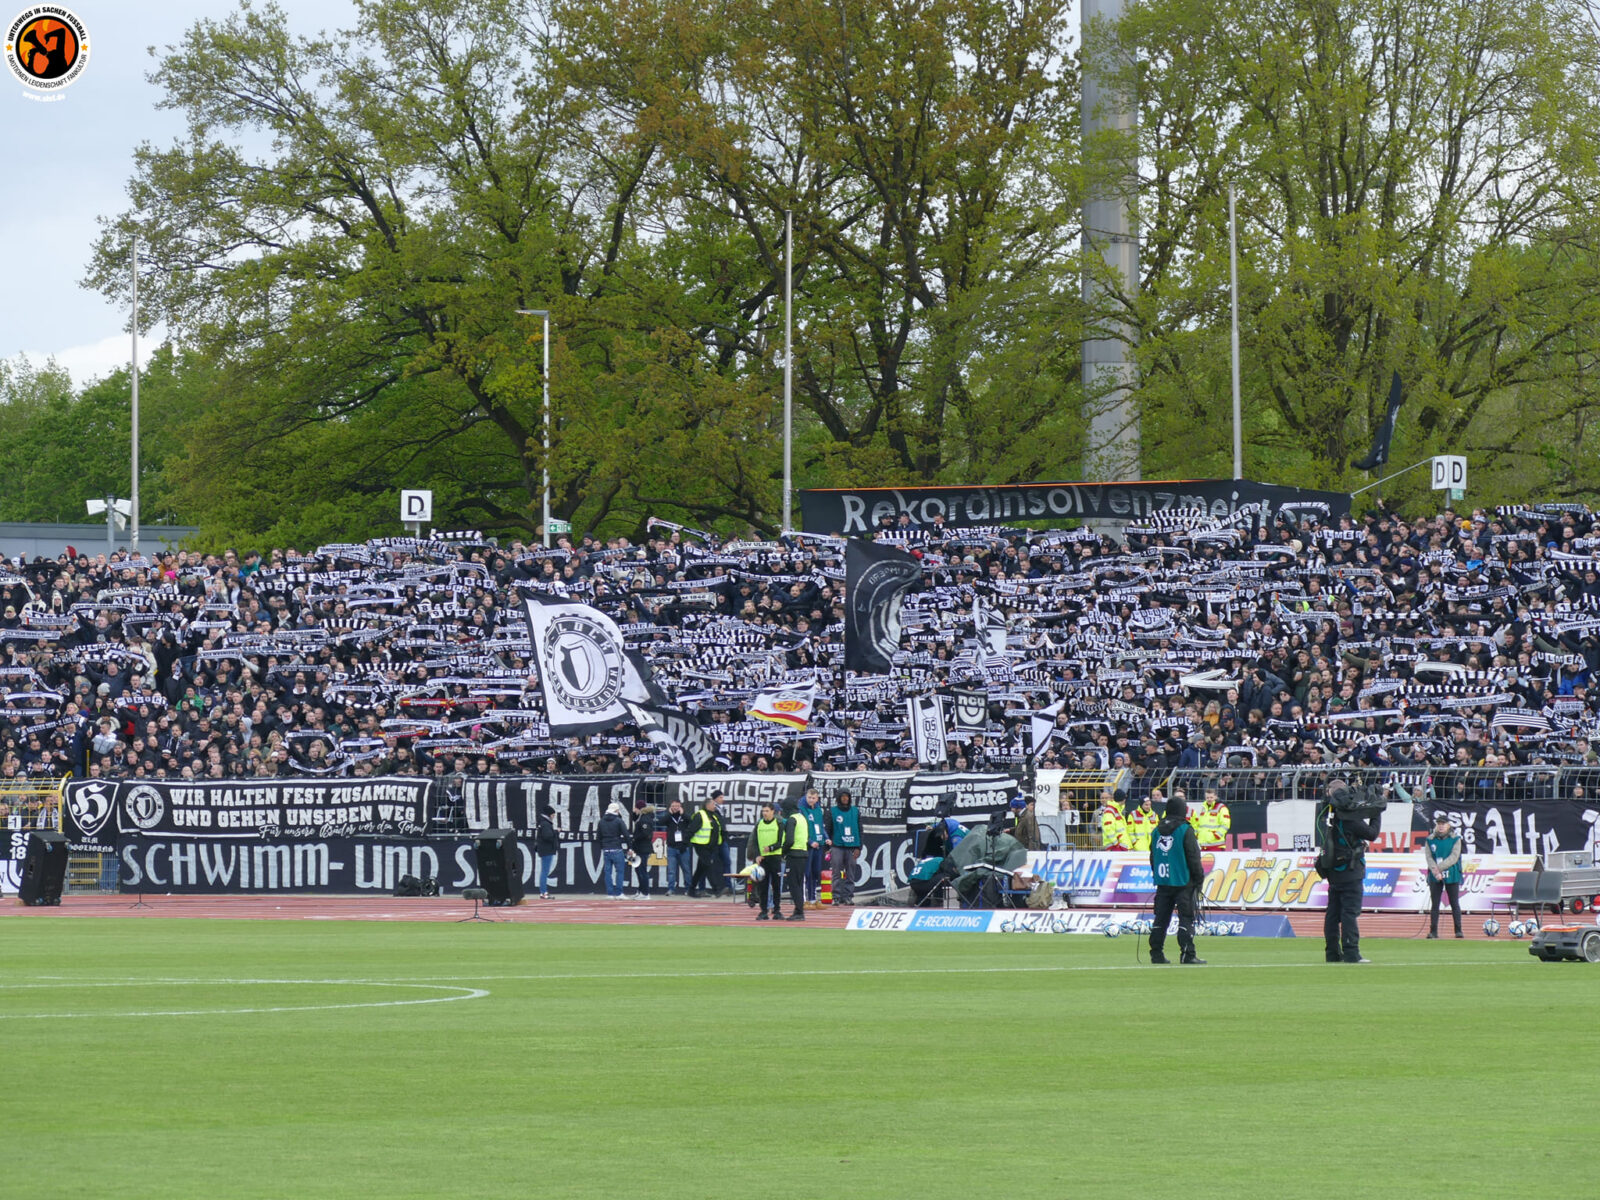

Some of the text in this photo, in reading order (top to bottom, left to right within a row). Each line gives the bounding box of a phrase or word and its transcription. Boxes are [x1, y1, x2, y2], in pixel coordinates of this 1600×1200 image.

[1436, 462, 1445, 483] D
[1452, 461, 1463, 483] D
[407, 495, 425, 516] D
[169, 784, 419, 806] WIR HALTEN FEST ZUSAMMEN
[946, 782, 974, 793] nero
[172, 804, 416, 828] UND GEHEN UNSEREN WEG
[465, 781, 633, 832] ULTRAS
[1129, 867, 1149, 878] Shop
[1244, 856, 1277, 869] möbel
[1367, 870, 1389, 880] unter
[868, 911, 982, 929] BITE E-RECRUITING
